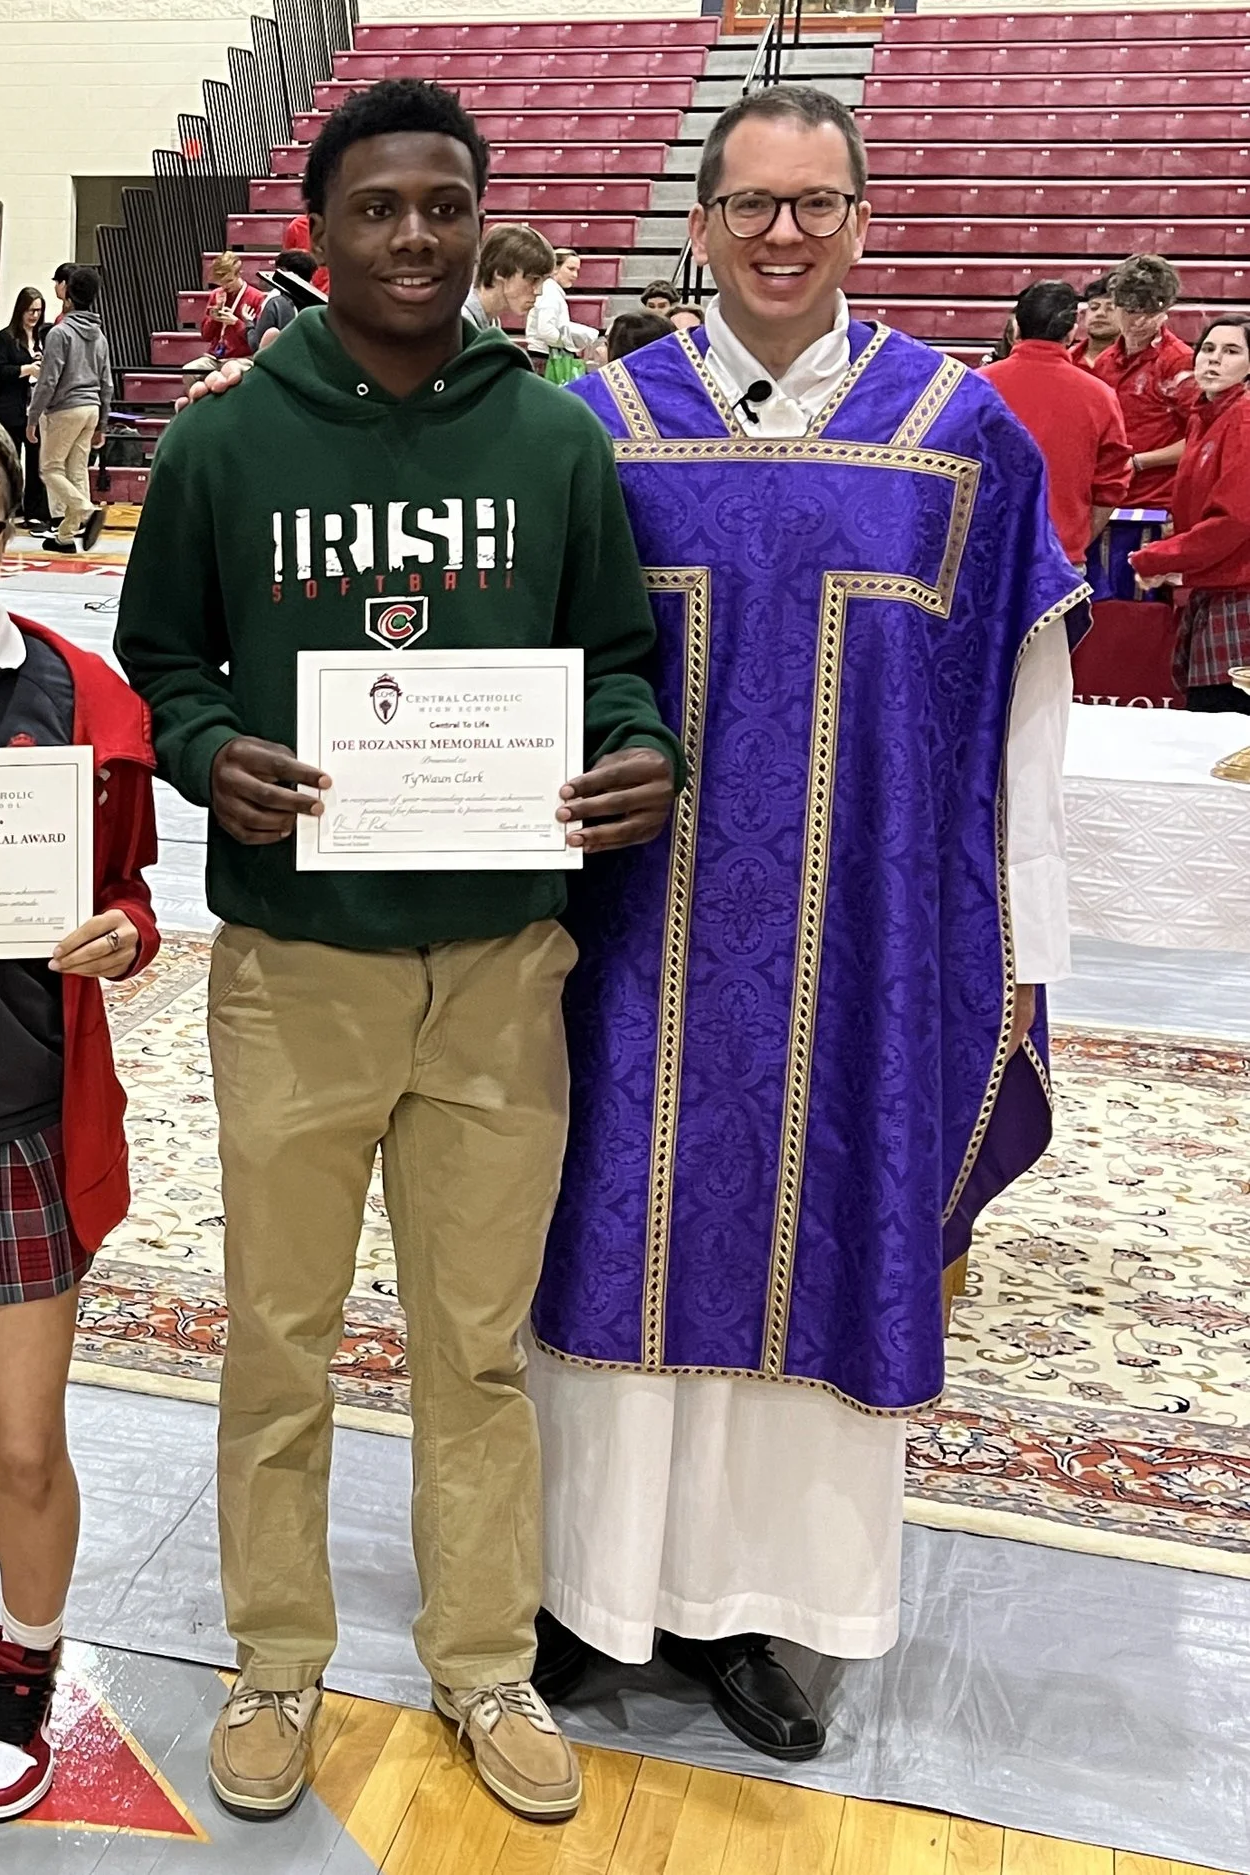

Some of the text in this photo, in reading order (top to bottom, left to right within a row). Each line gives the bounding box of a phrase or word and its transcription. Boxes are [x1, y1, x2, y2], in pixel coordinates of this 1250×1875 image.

[272, 498, 516, 583] IRISH
[331, 737, 554, 751] JOE ROZANSKI MEMORIAL AWARD
[454, 772, 483, 783] Clark
[20, 833, 65, 843] AWARD
